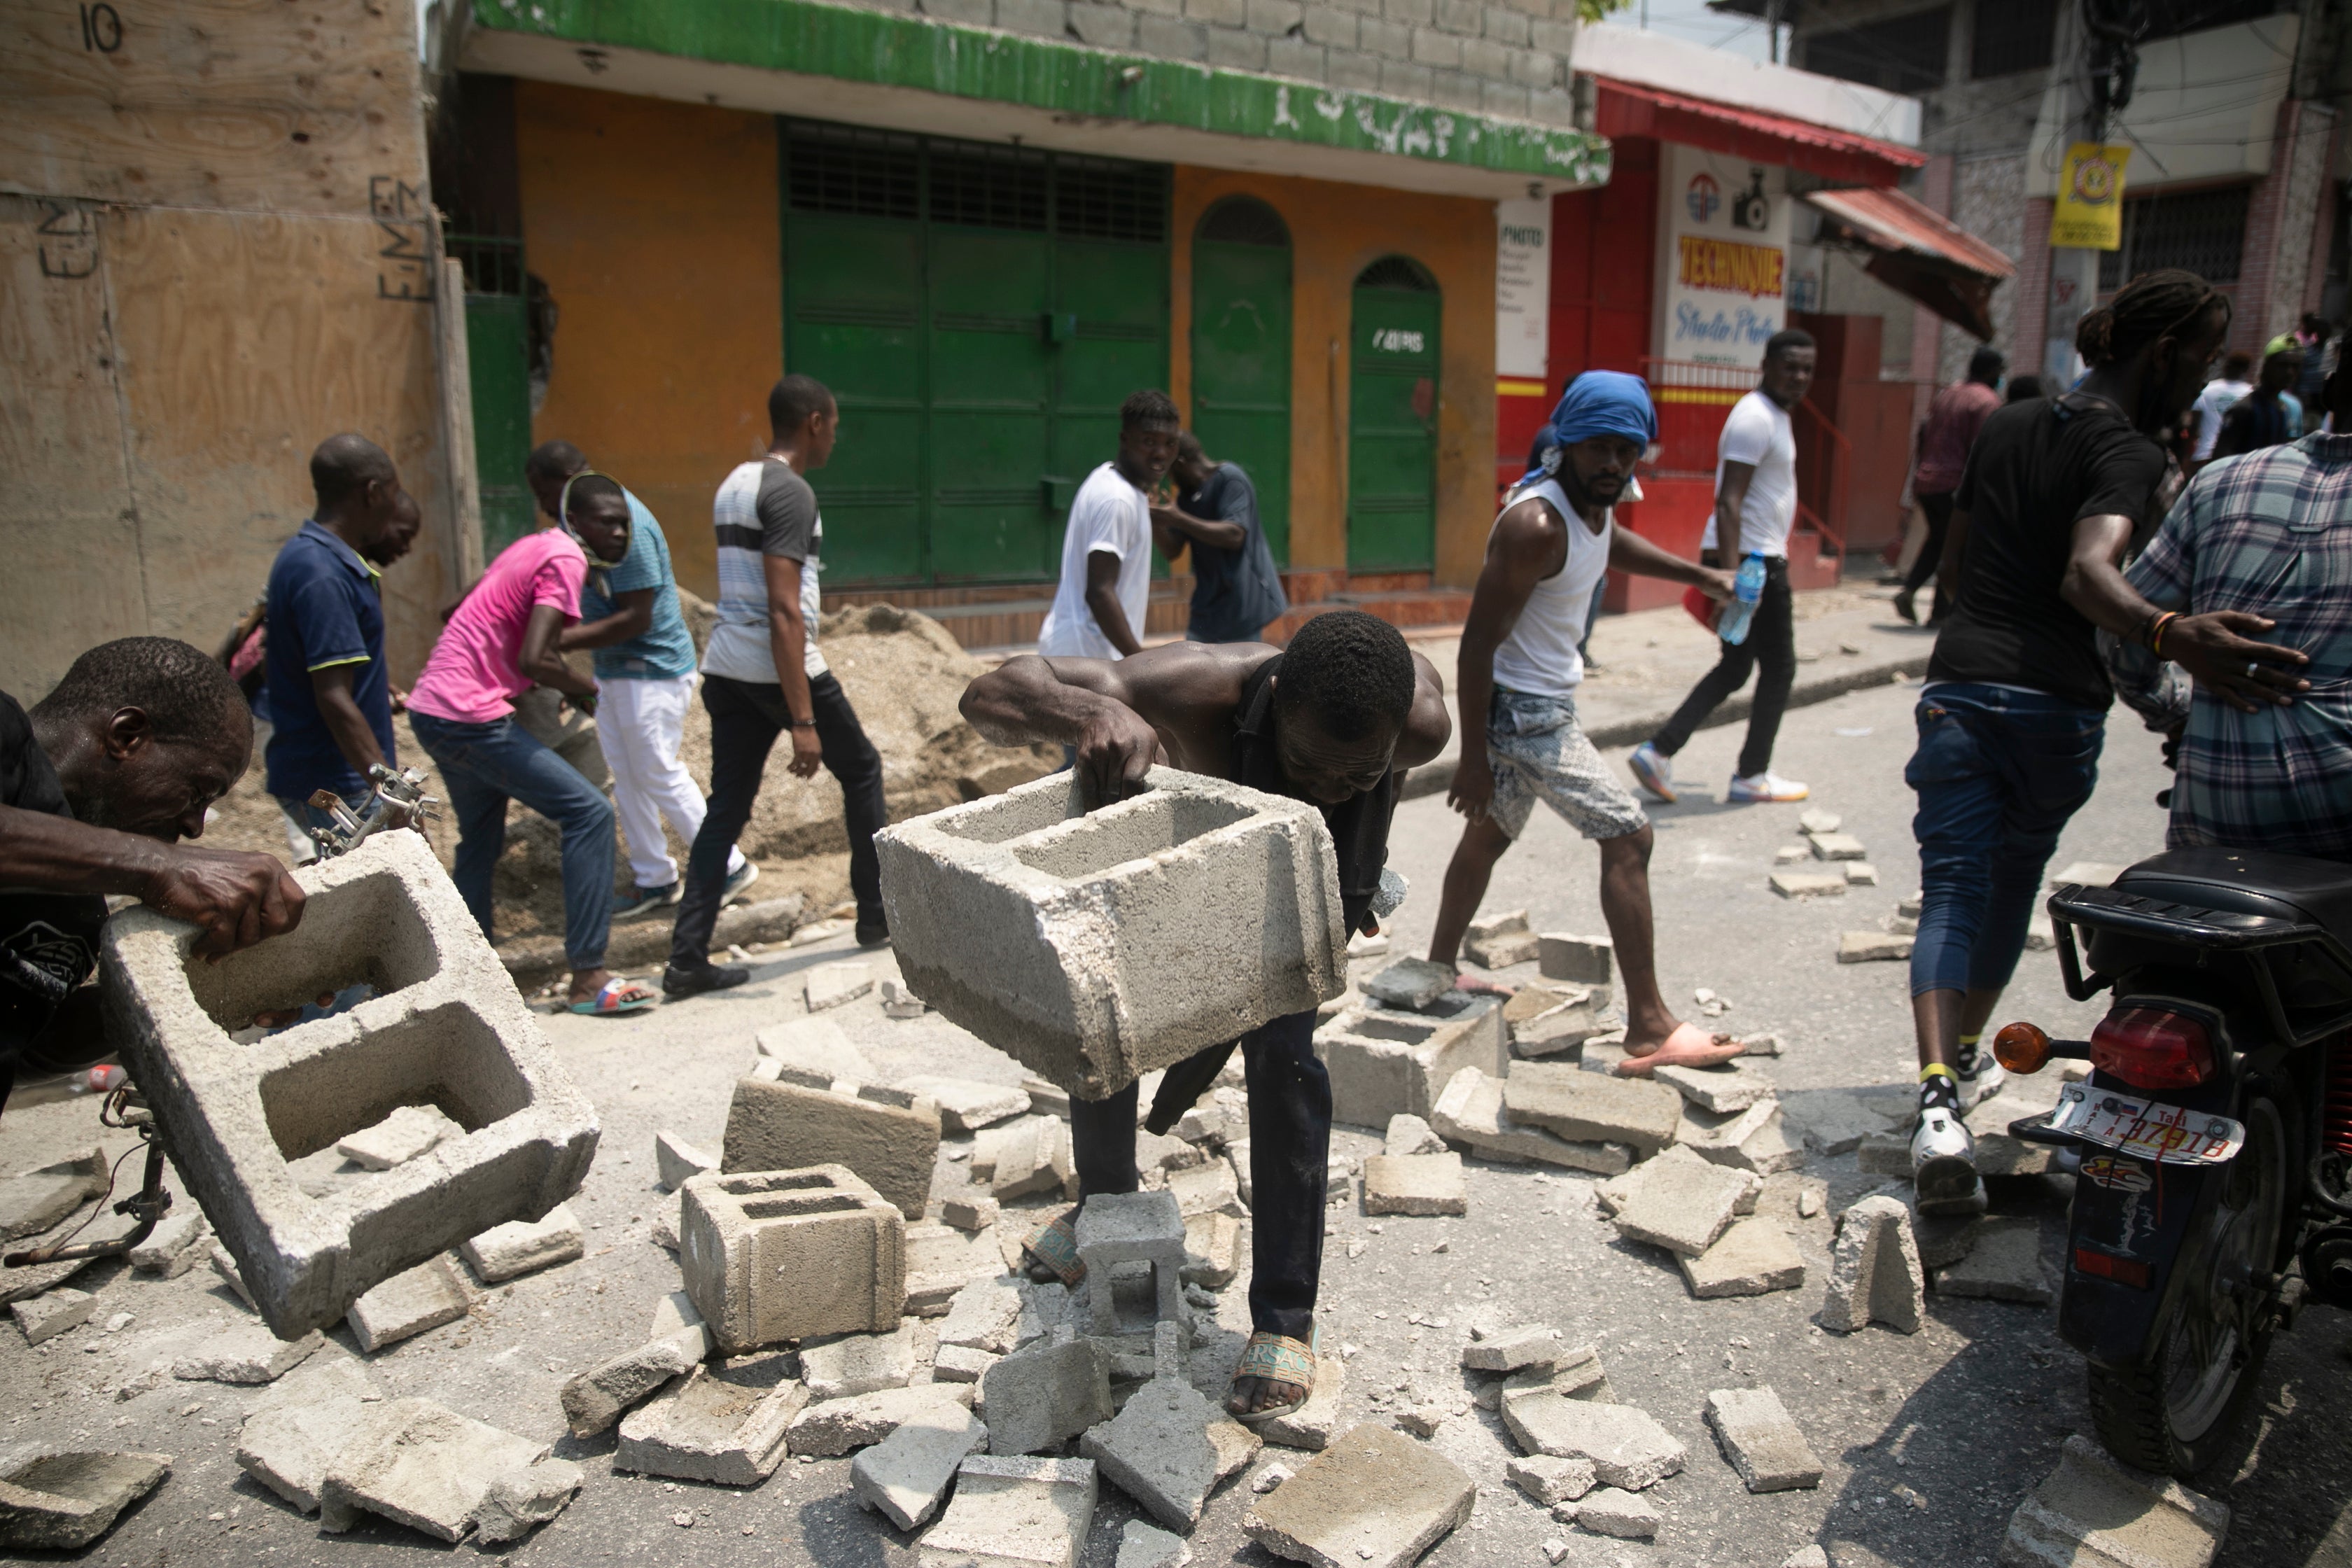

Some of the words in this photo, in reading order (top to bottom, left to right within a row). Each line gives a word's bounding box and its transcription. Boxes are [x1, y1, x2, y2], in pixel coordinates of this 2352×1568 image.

[79, 2, 122, 53] 10
[1500, 223, 1544, 248] PHOTO
[1678, 234, 1784, 300] TECHNIQUE
[1674, 300, 1732, 342] Studio
